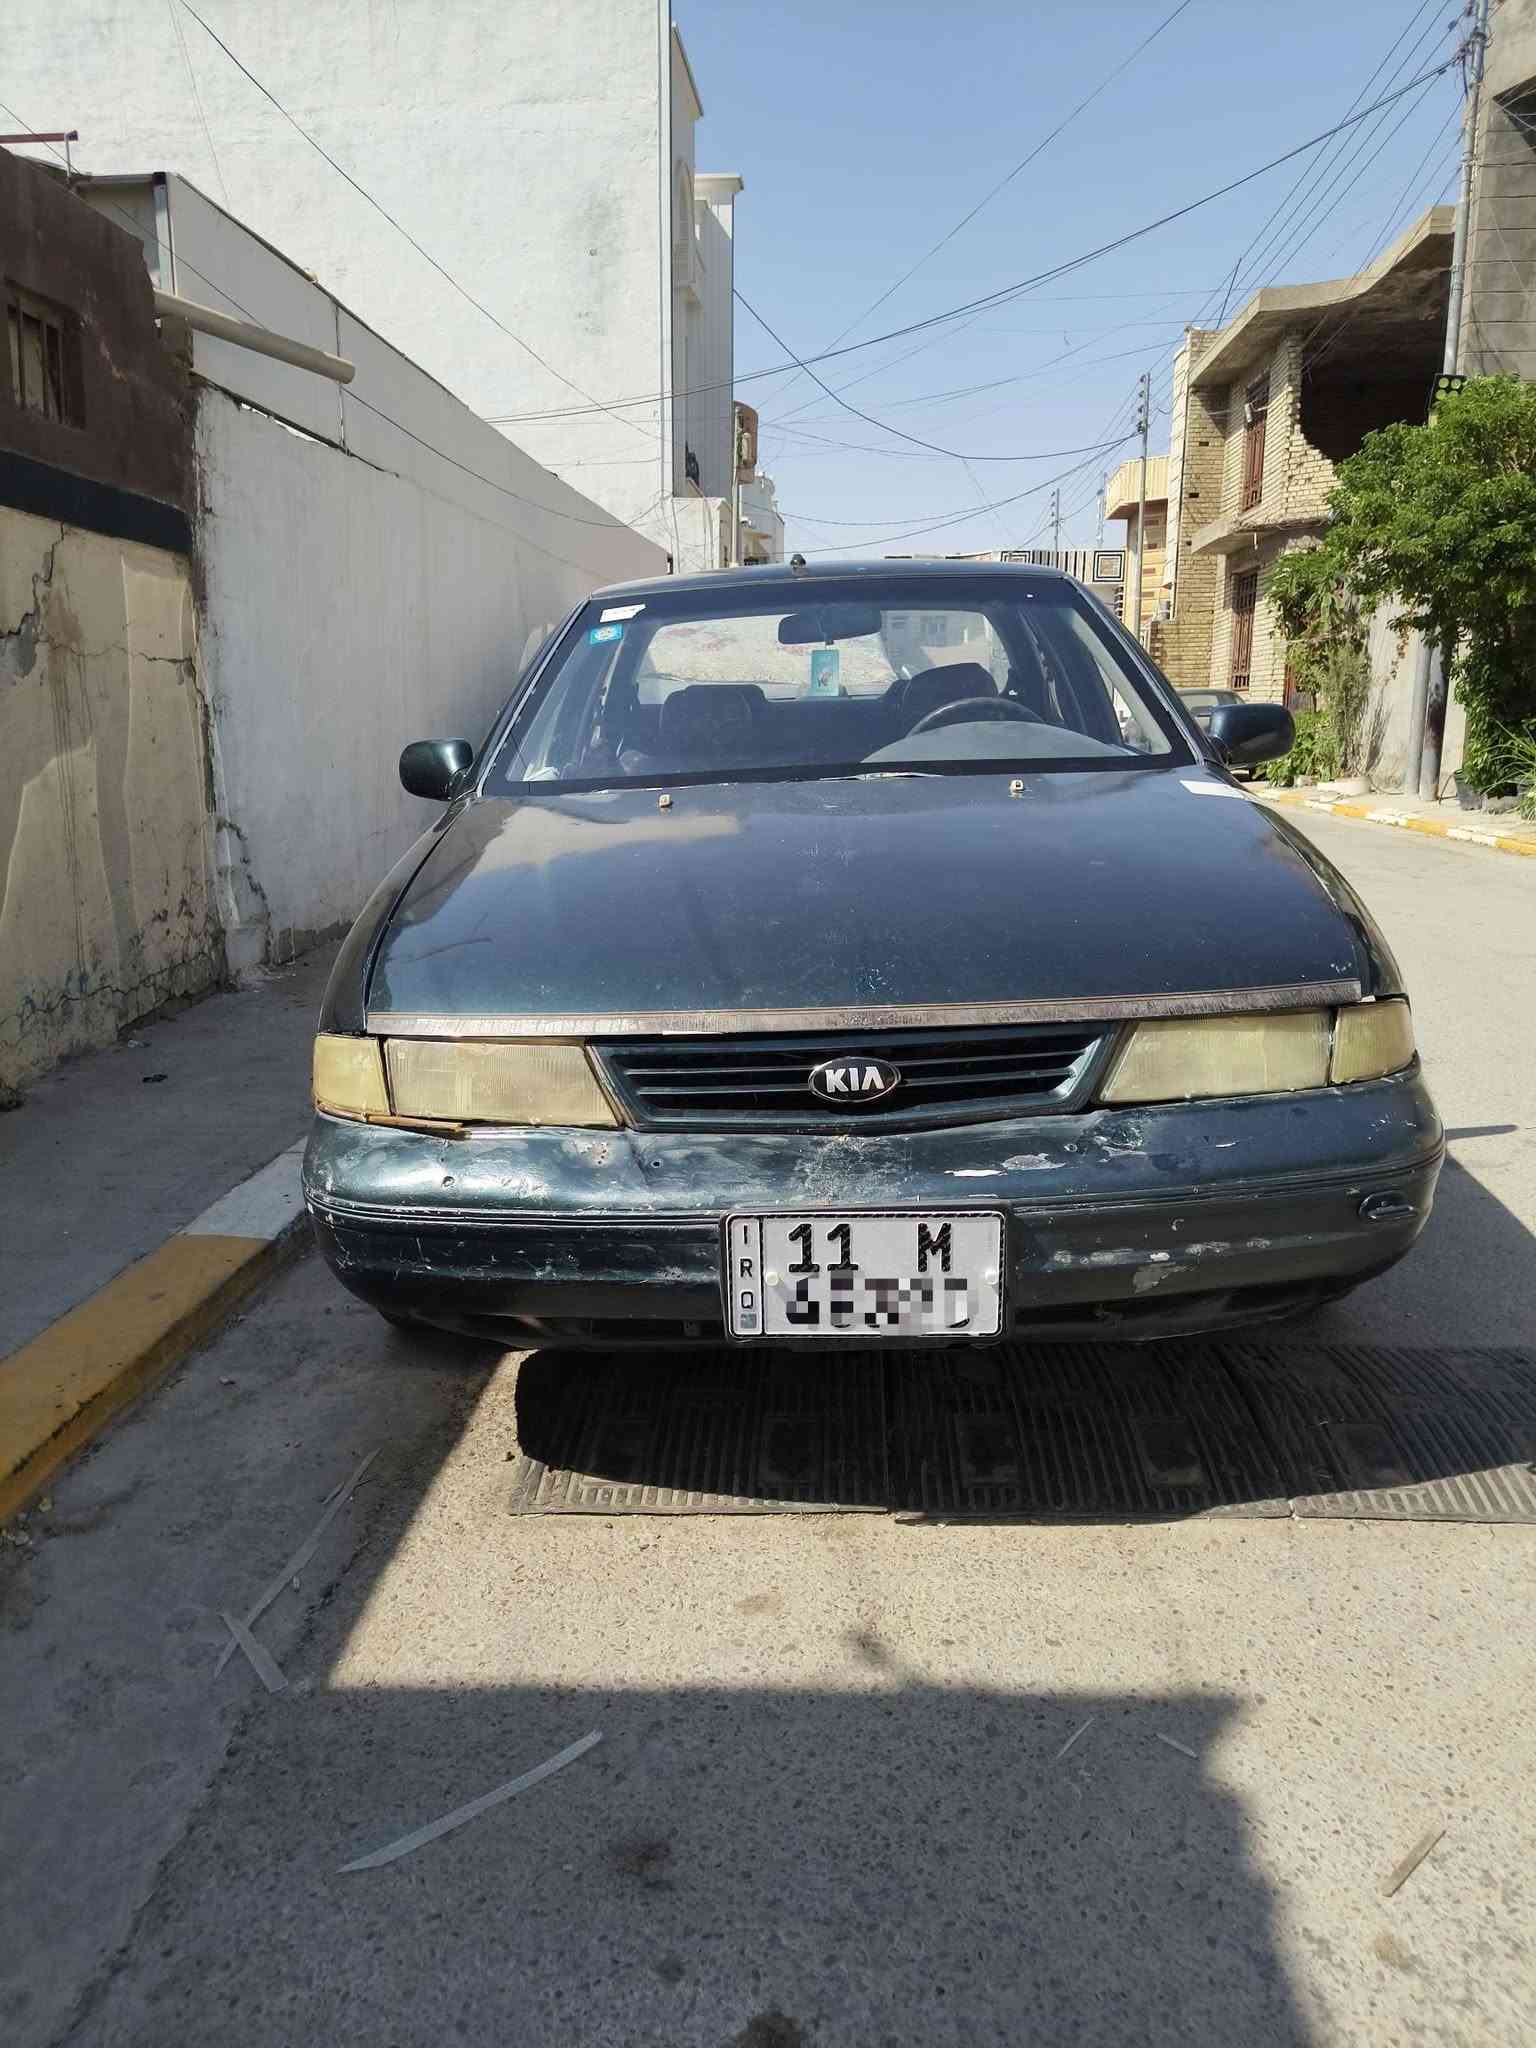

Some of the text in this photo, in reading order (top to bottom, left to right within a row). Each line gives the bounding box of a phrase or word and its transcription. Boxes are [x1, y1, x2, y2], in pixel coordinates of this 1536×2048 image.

[825, 1066, 885, 1093] KIA
[739, 1225, 754, 1309] IRQ
[788, 1223, 951, 1272] 11 M
